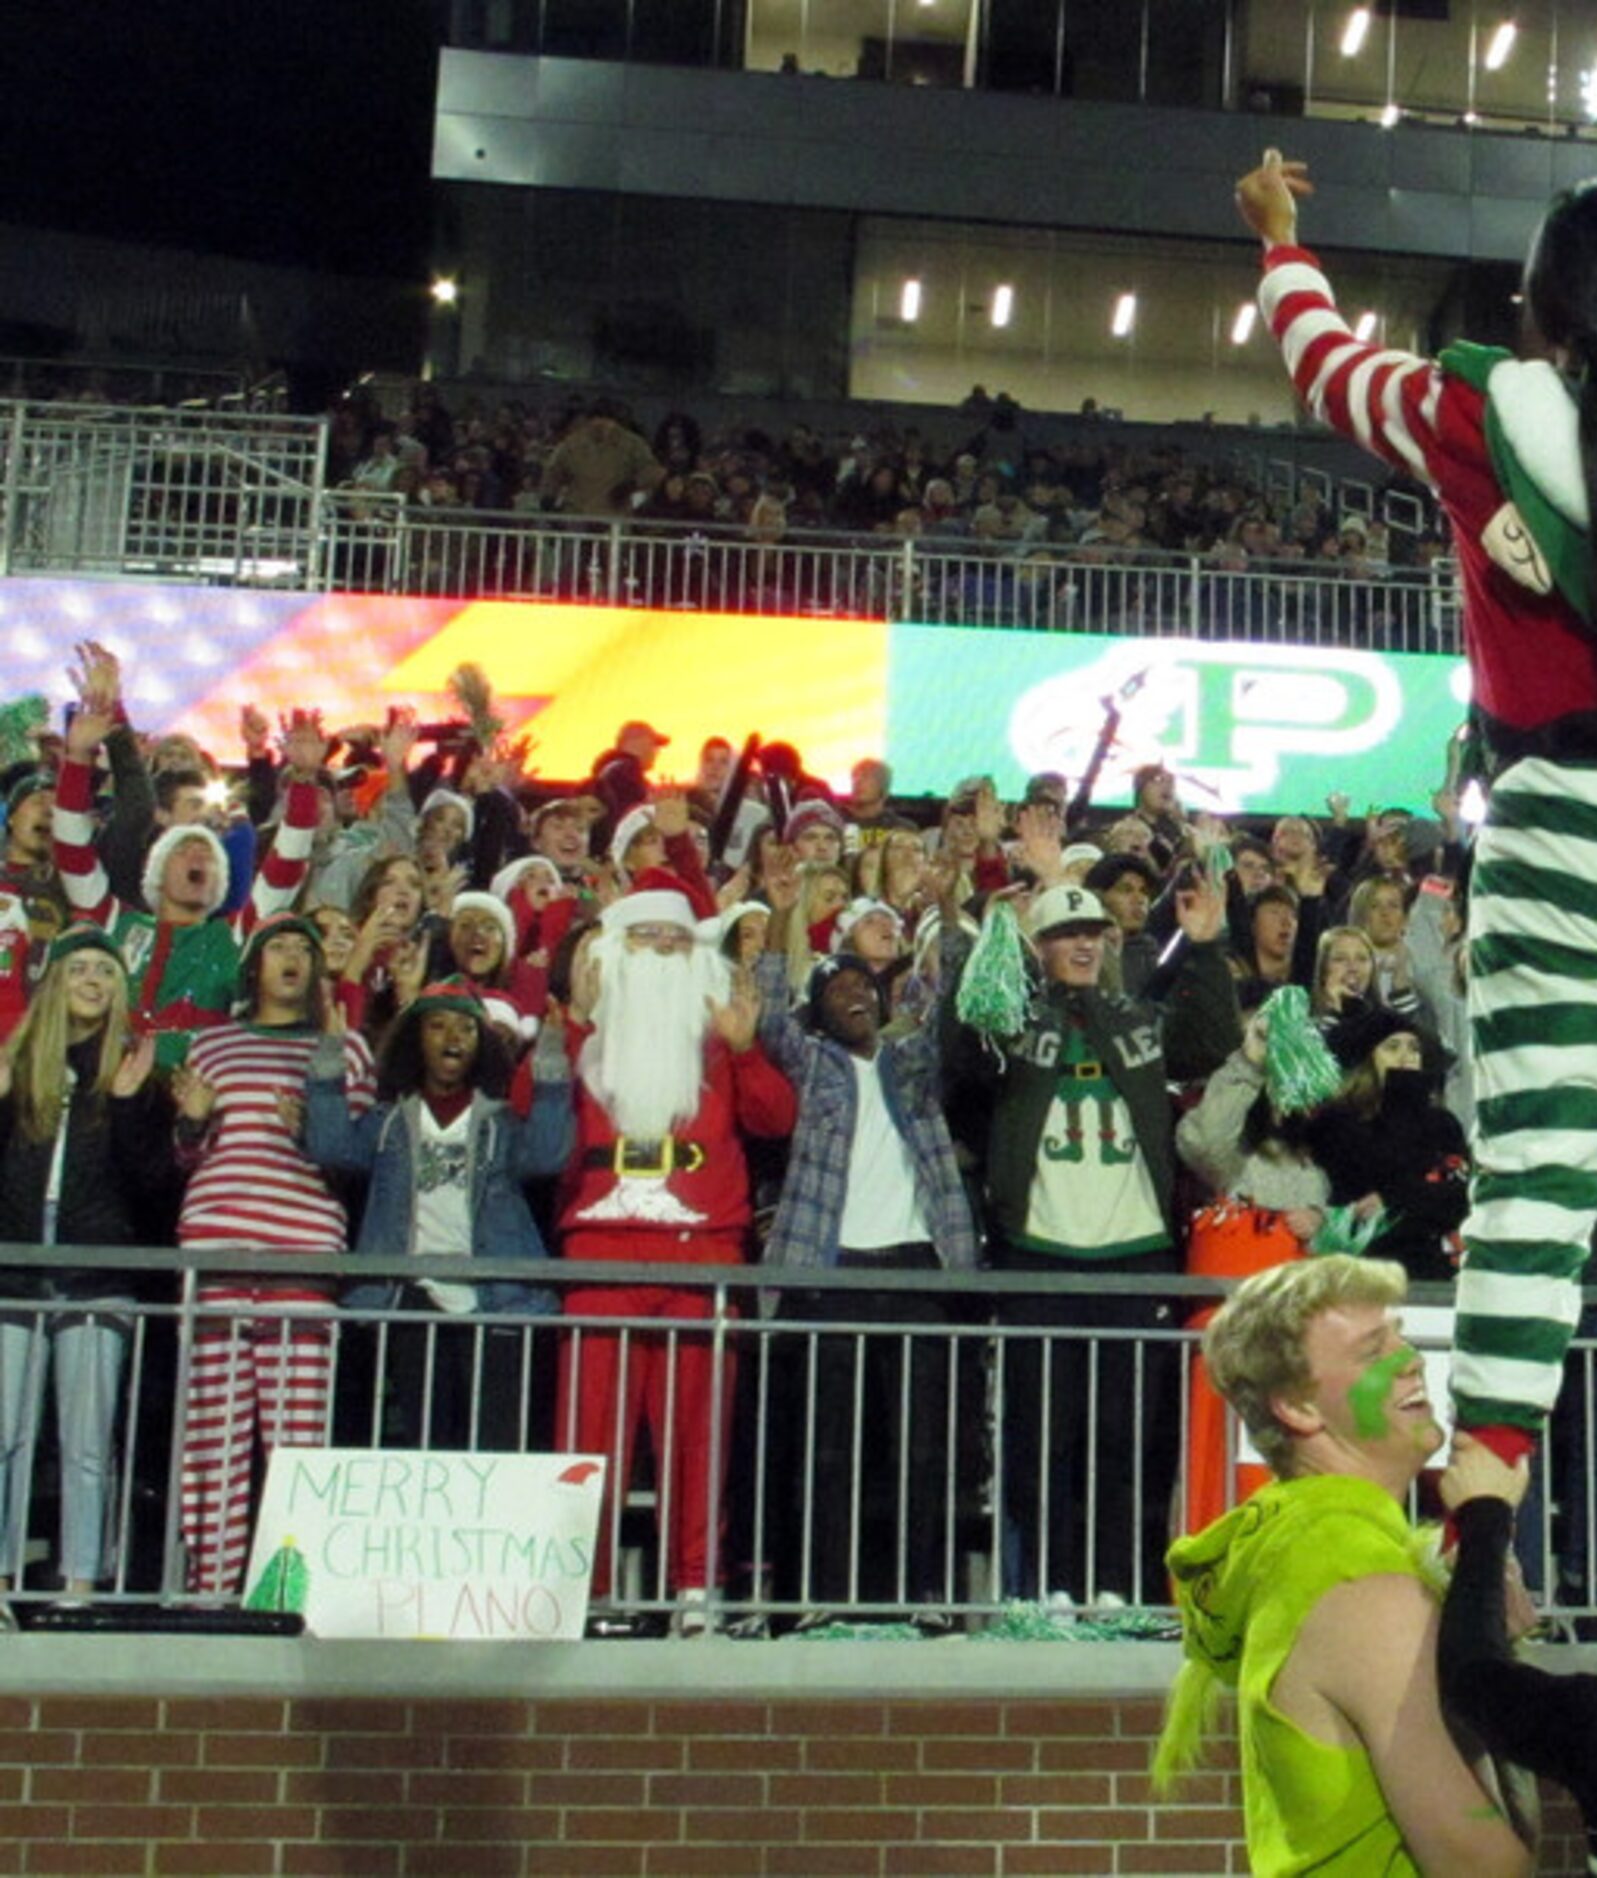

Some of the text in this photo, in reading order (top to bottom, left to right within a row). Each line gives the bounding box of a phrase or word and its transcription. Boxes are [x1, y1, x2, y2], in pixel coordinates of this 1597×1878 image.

[1176, 659, 1378, 770] P
[1065, 889, 1084, 912] P
[288, 1457, 499, 1520] MERRY
[323, 1522, 590, 1580] CHRISTMAS
[371, 1578, 563, 1640] PLANO
